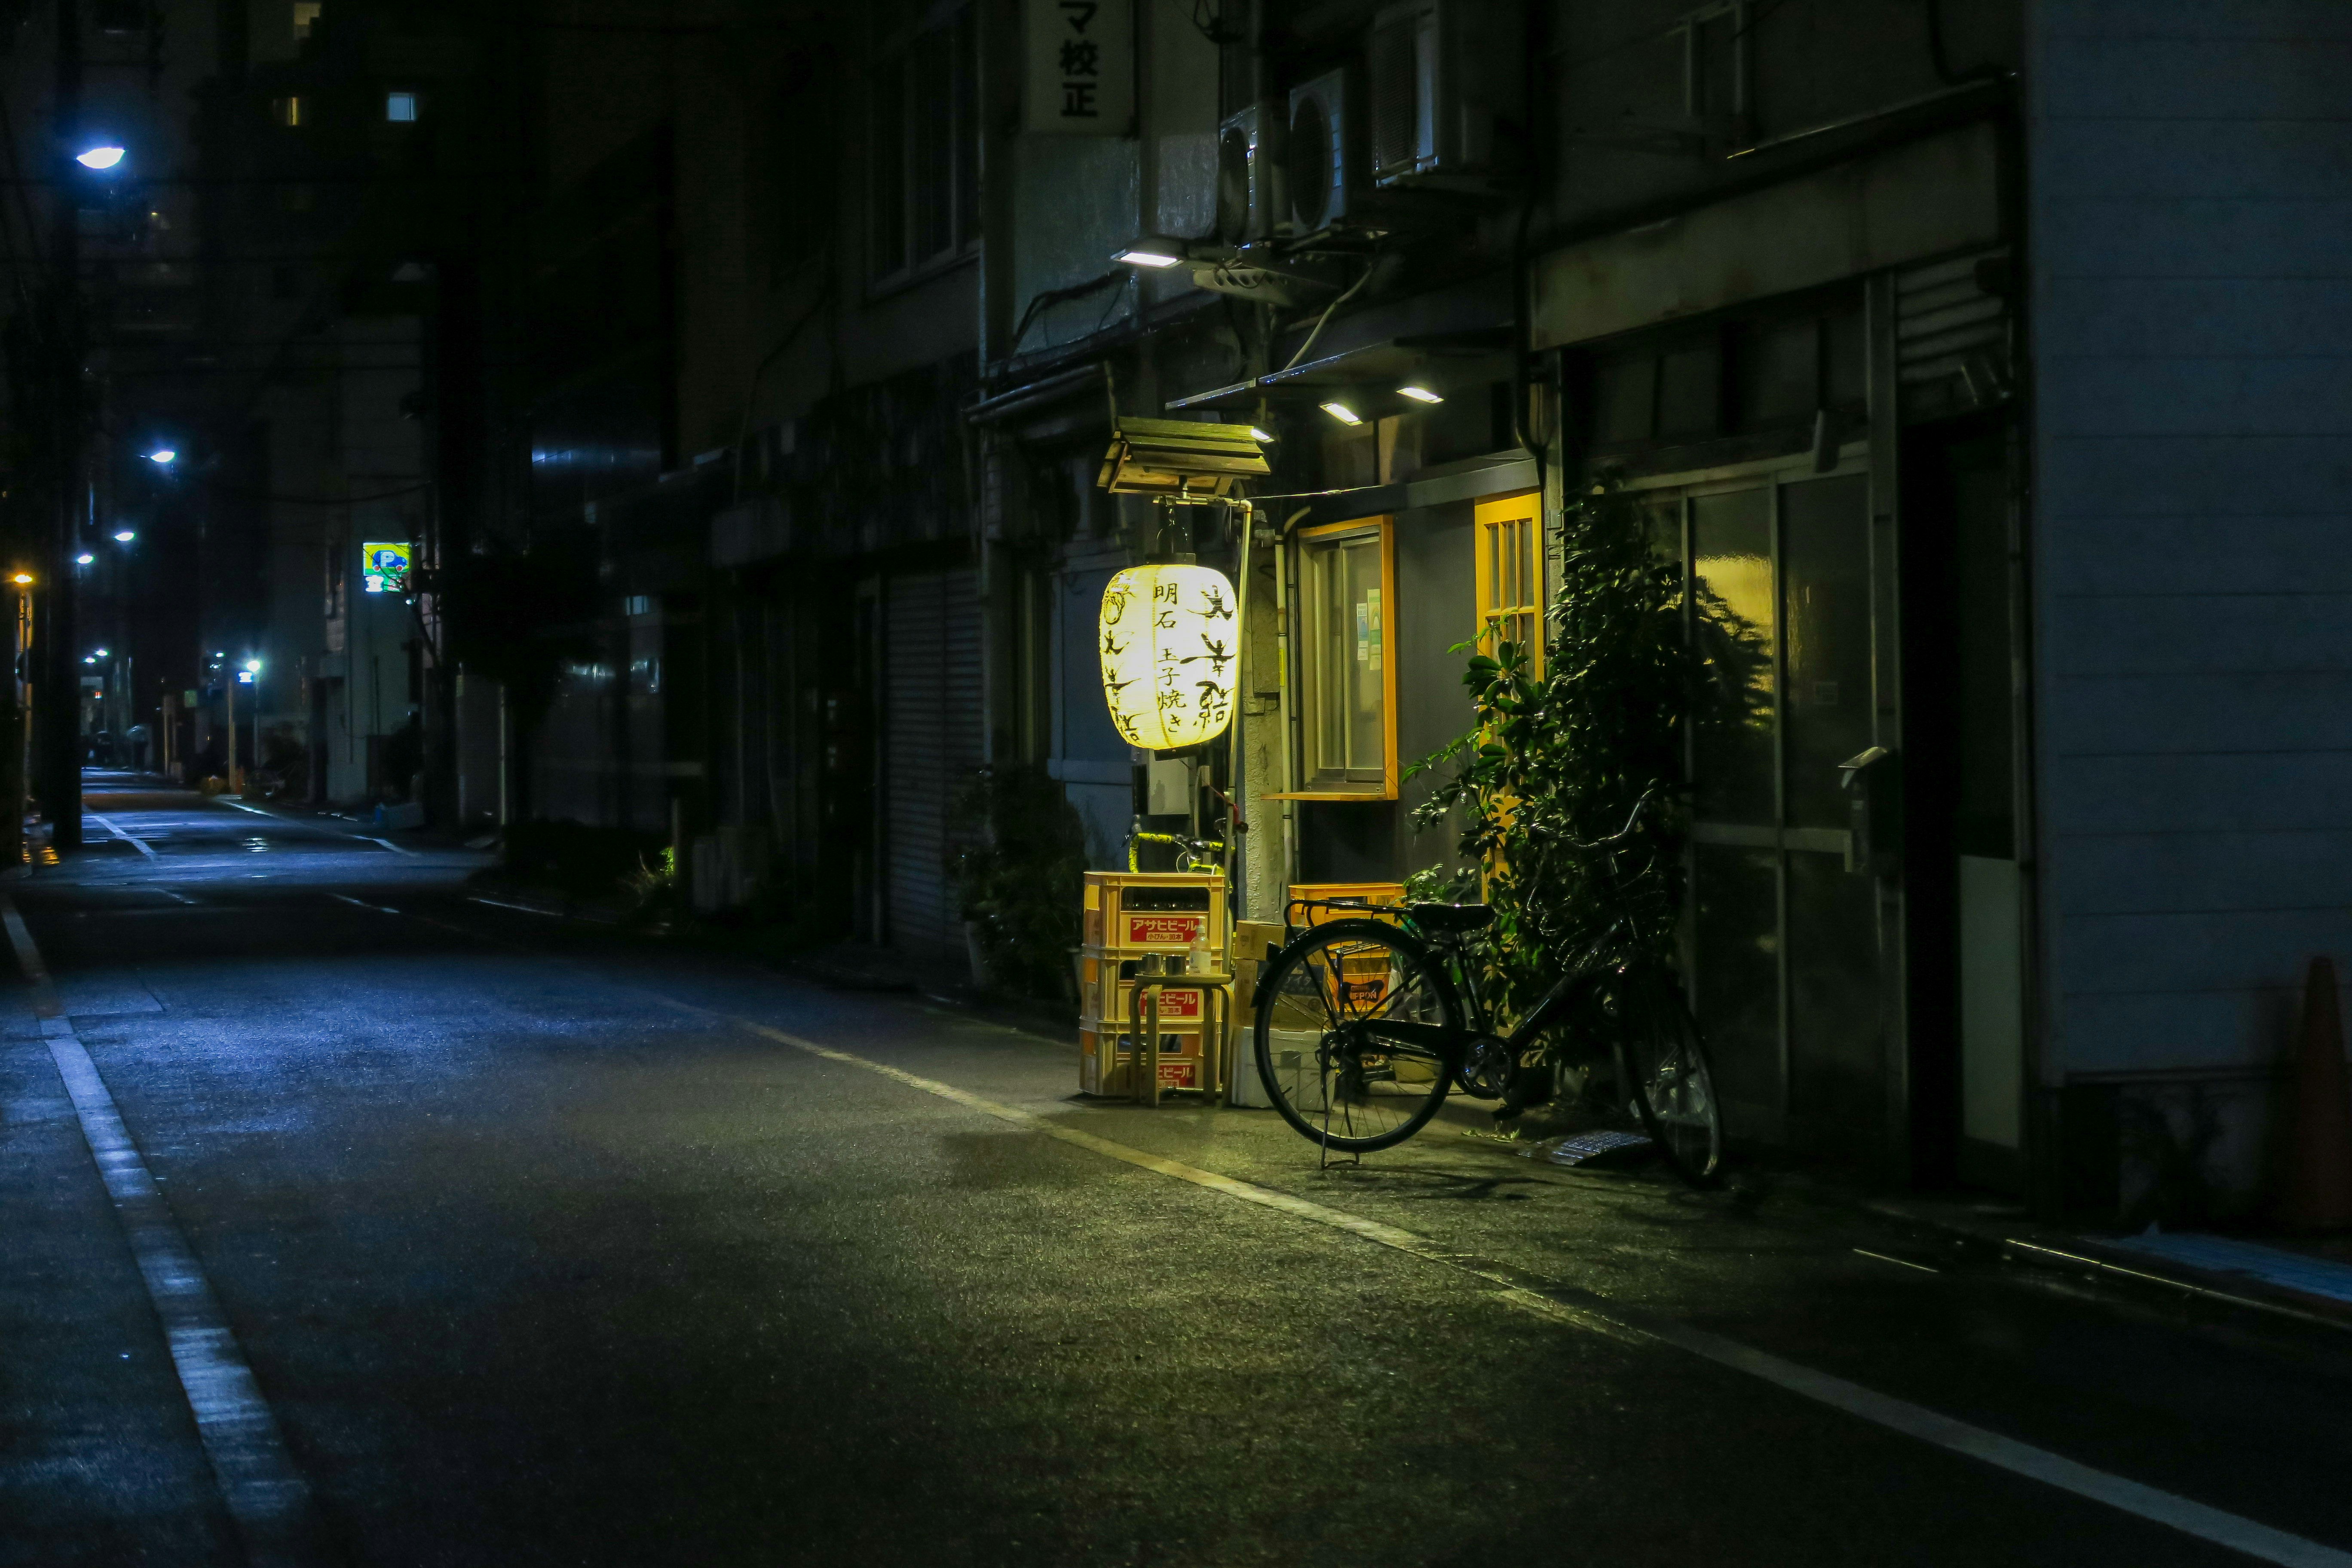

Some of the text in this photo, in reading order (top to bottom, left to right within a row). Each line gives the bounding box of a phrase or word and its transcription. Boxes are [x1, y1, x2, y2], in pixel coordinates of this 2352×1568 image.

[380, 551, 395, 567] P
[1154, 583, 1187, 732] 明石 玉子焼き
[1133, 920, 1198, 931] アサヒビール
